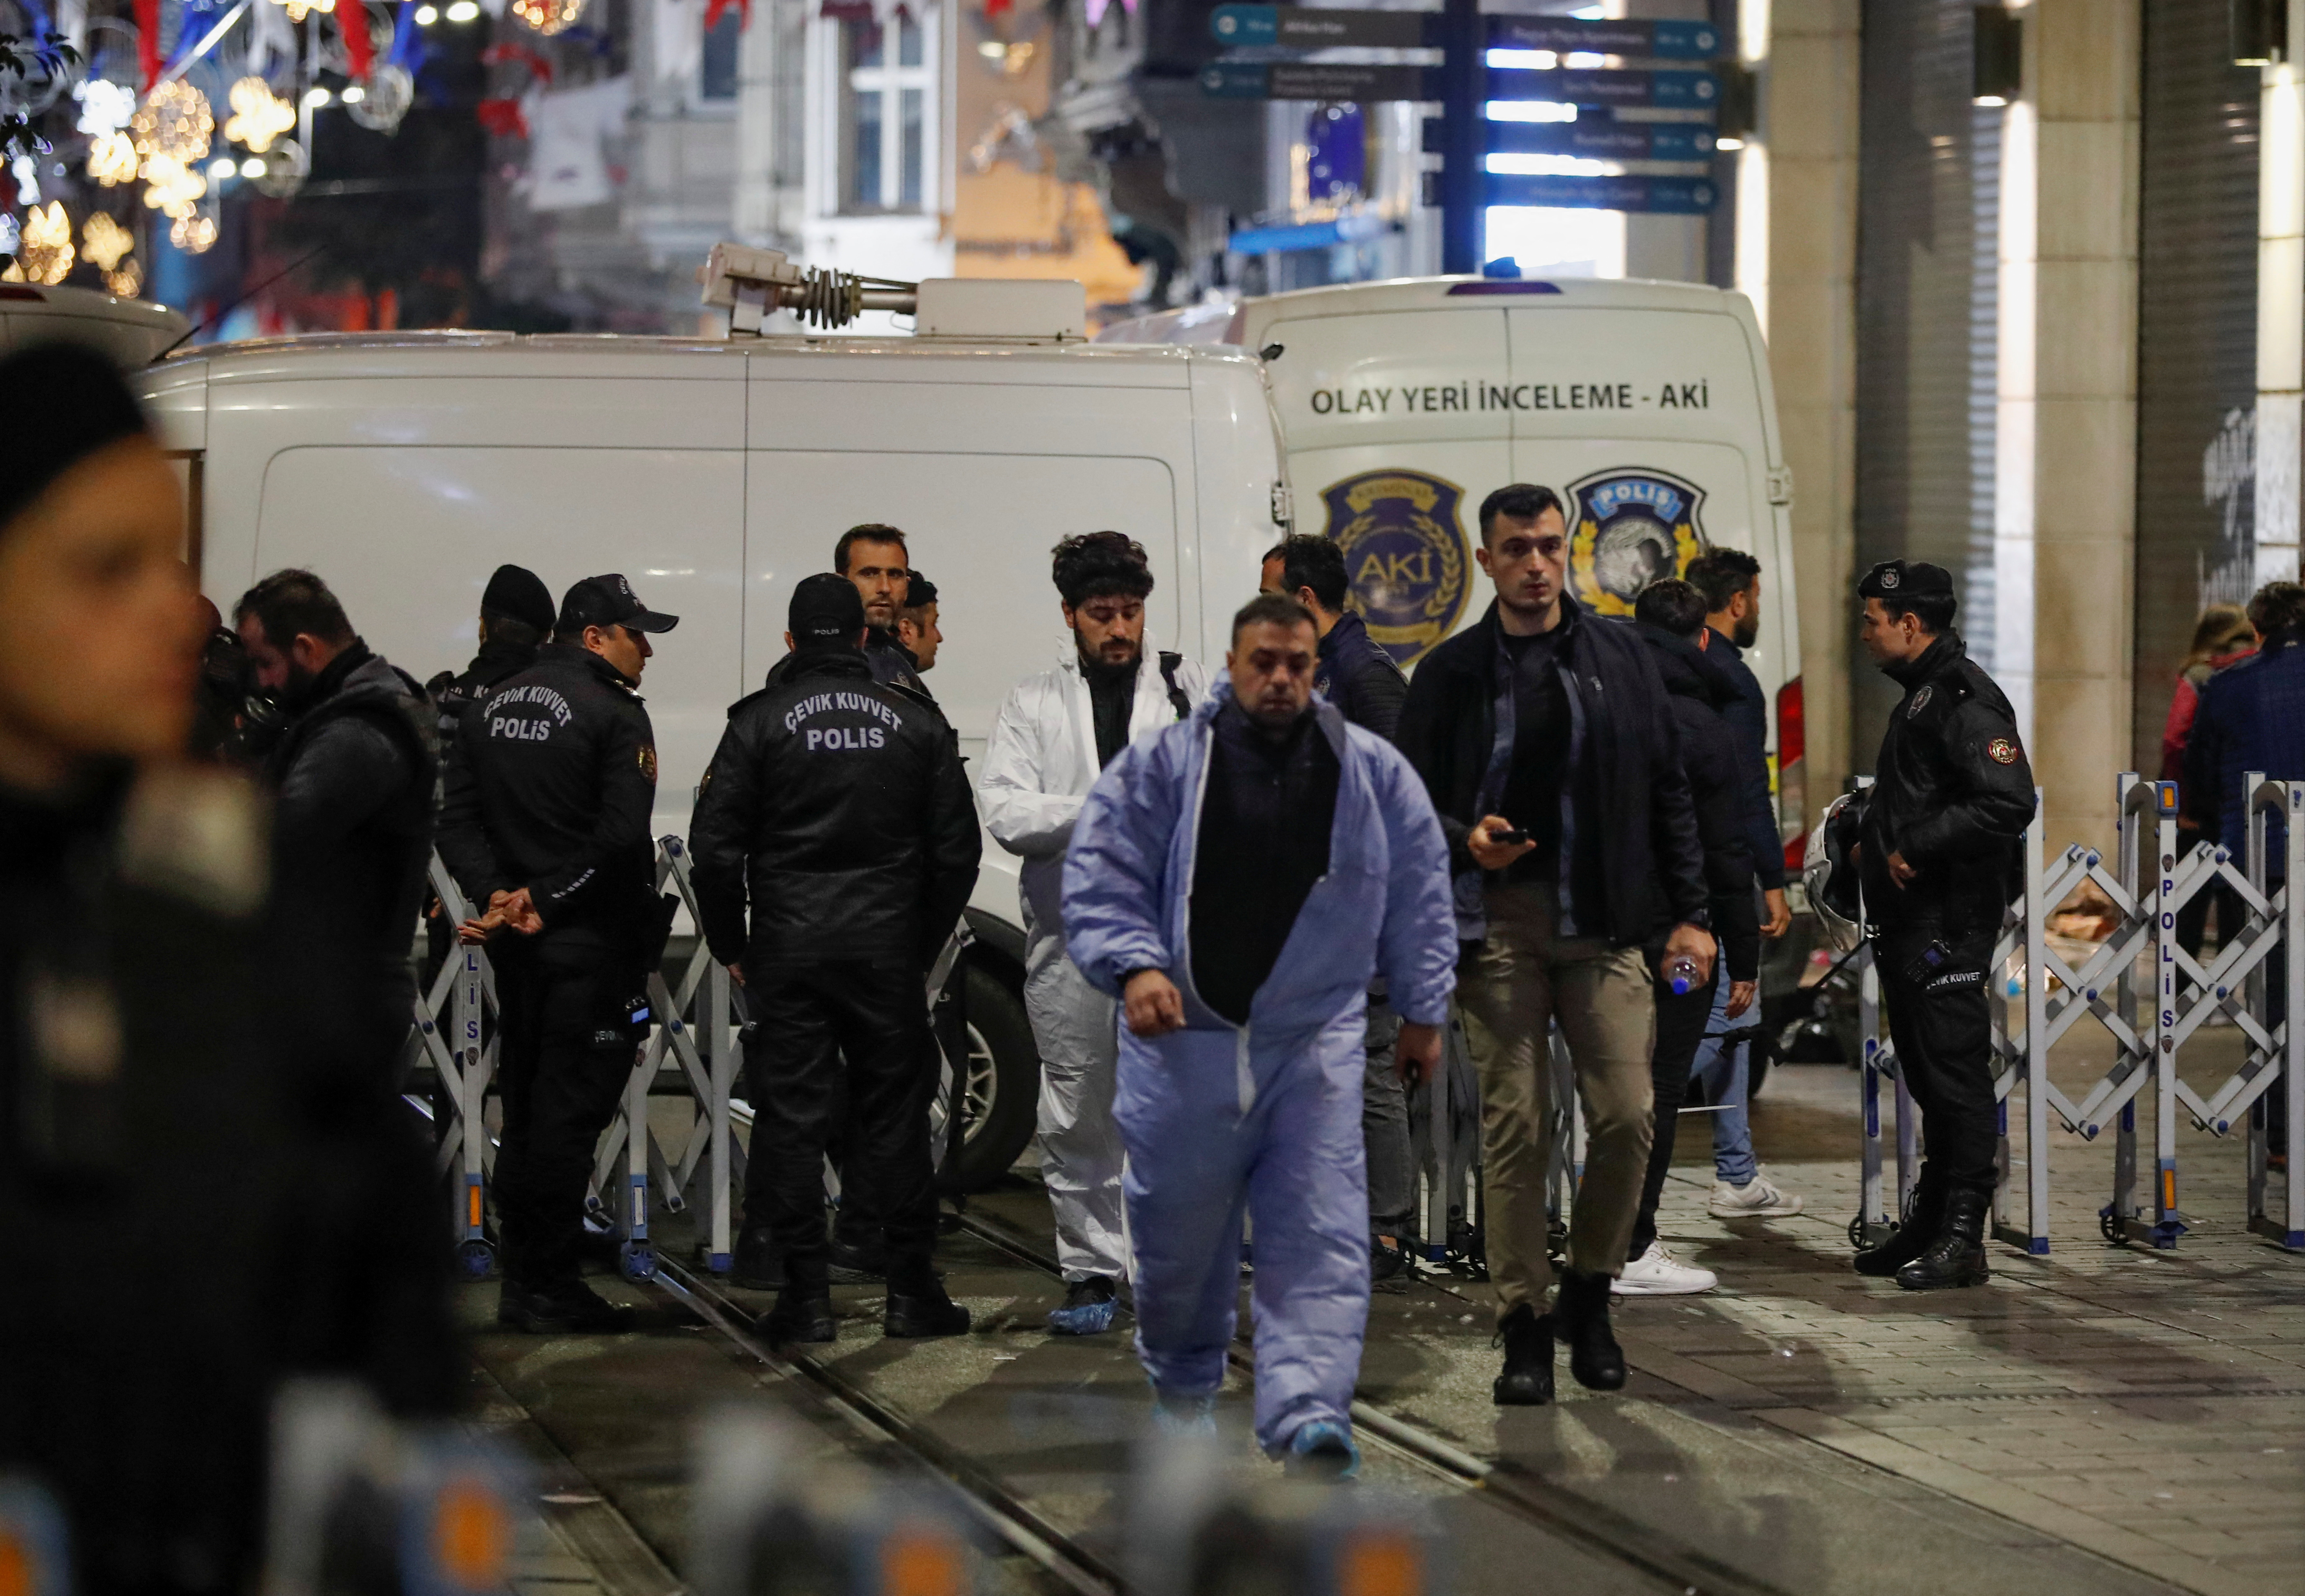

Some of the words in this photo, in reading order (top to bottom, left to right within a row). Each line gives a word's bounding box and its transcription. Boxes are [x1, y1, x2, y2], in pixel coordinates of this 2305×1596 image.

[1311, 387, 1392, 414] OLAY
[1401, 380, 1469, 412] YERİ
[1479, 380, 1633, 410] İNCELEME
[1659, 378, 1709, 409] AKİ
[527, 686, 573, 727] KUVVET
[785, 693, 833, 735] ÇEVİK
[836, 692, 902, 732] KUVVET
[807, 727, 884, 751] POLİS
[2161, 879, 2174, 1027] POLİS
